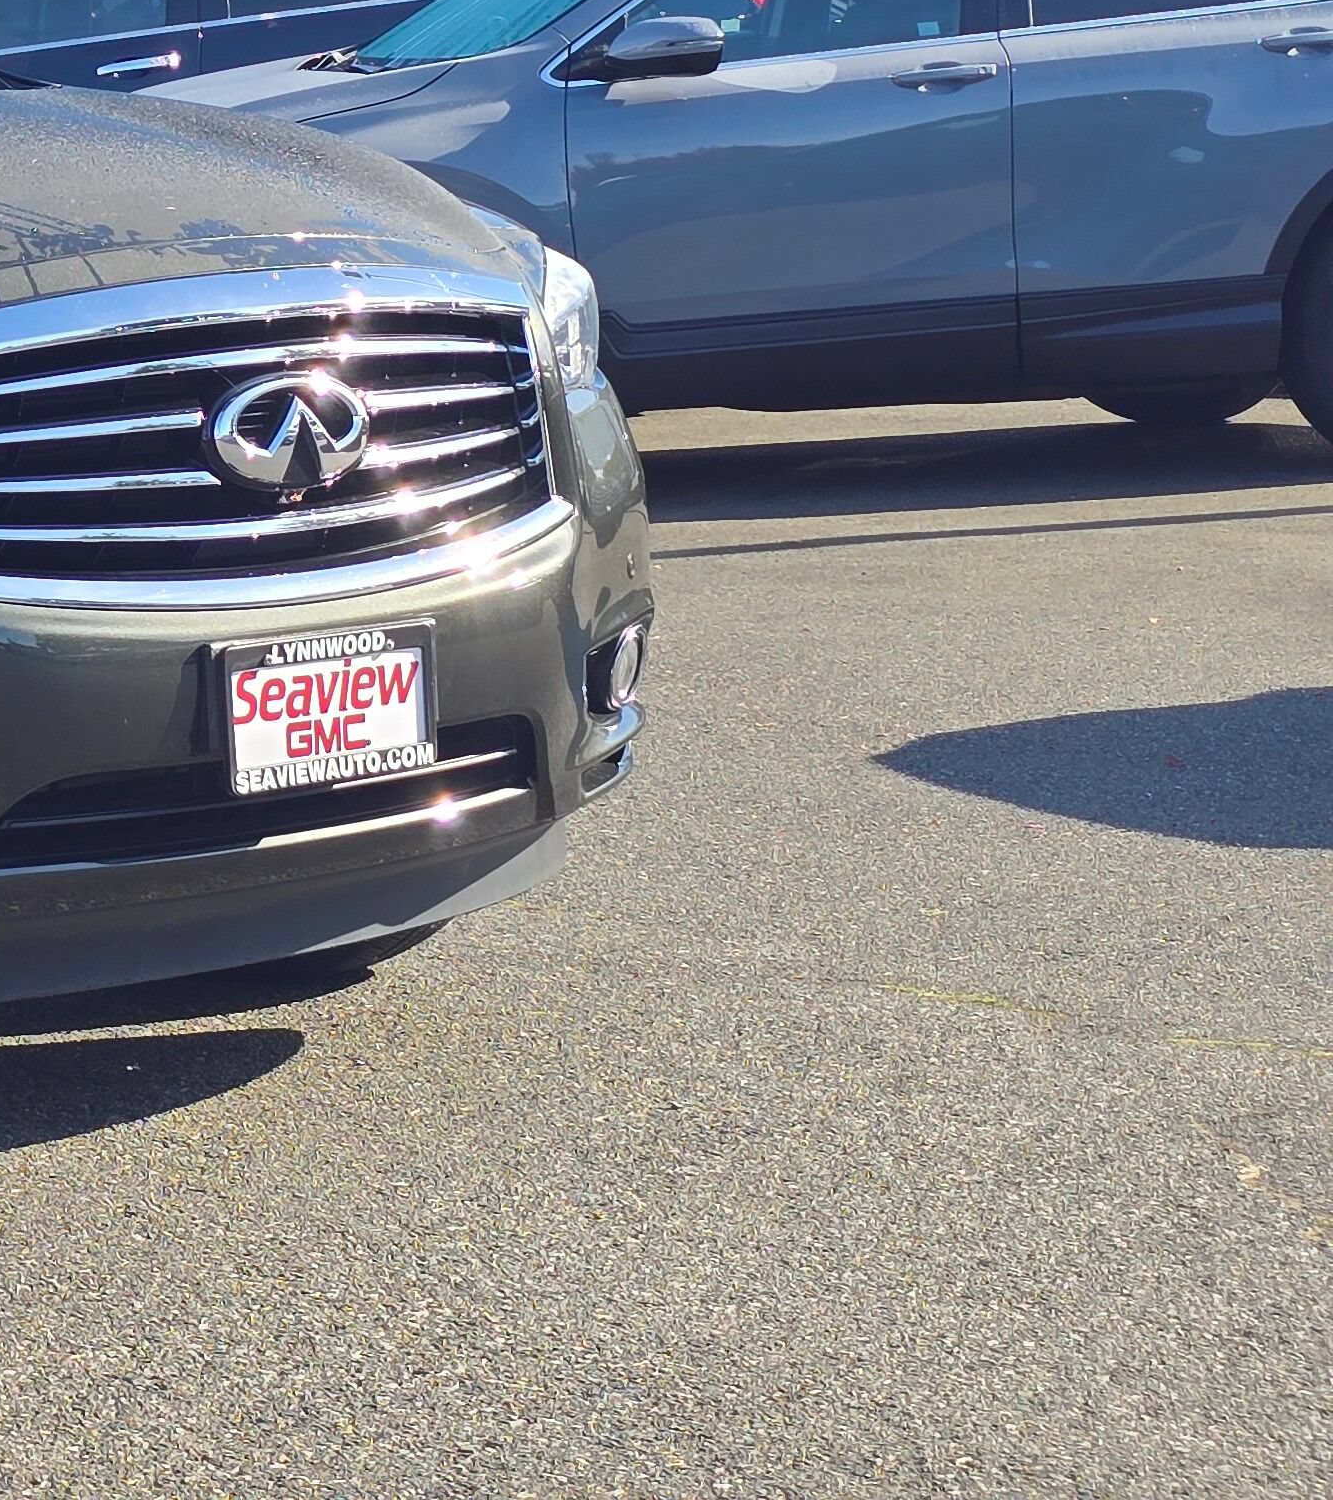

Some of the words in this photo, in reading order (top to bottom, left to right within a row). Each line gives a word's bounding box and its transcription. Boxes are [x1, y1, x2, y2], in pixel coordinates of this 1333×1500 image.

[270, 631, 386, 664] LYNNWOOD
[233, 657, 419, 726] Seaview
[286, 713, 371, 758] GMC
[234, 743, 434, 795] SEAVIEWAUTO.COM
